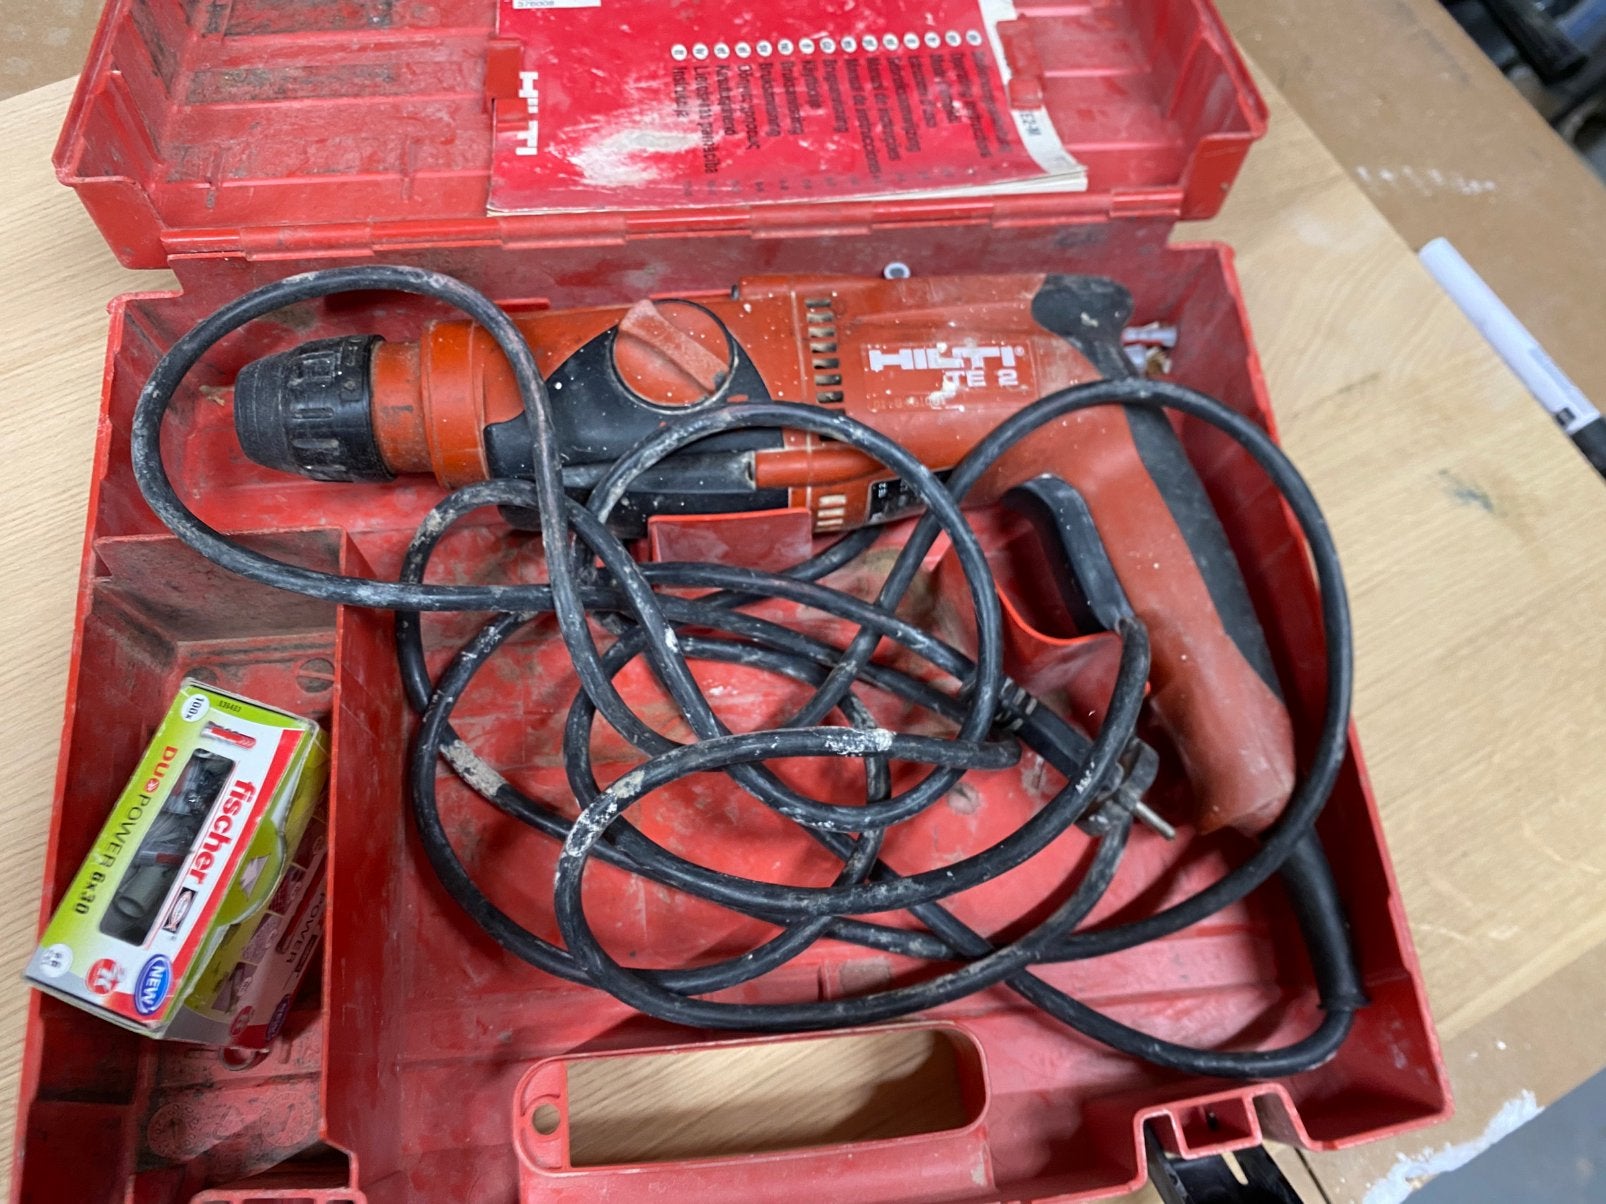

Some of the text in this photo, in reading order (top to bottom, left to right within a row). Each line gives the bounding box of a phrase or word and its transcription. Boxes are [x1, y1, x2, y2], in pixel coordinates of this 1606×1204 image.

[868, 346, 1016, 372] HILTI
[942, 368, 1018, 387] TE 2
[185, 697, 205, 720] 100x
[189, 779, 257, 885] fischer
[140, 964, 167, 1006] NEW
